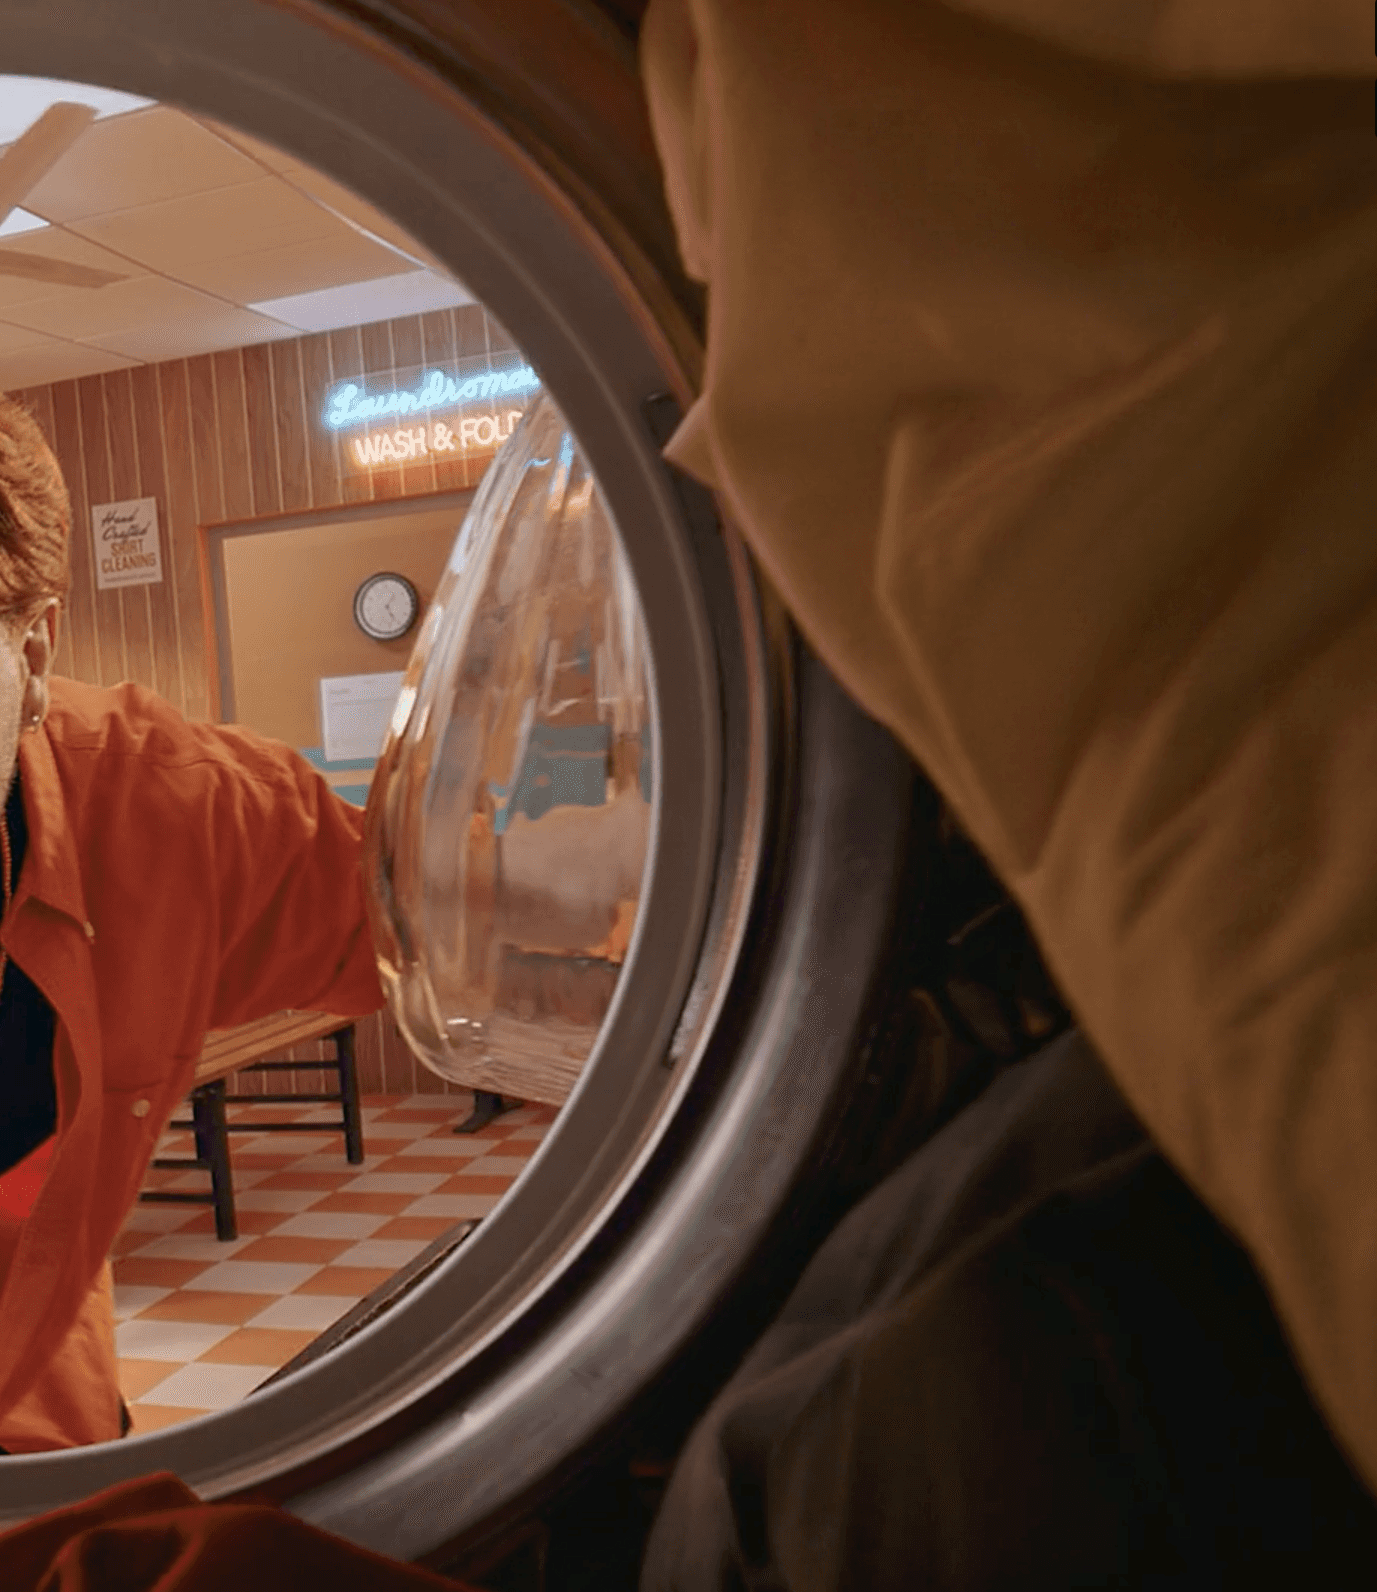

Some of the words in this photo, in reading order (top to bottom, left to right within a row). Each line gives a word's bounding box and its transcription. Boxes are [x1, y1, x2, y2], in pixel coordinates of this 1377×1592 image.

[328, 364, 541, 426] Laundroma
[354, 427, 428, 465] WASH
[433, 422, 455, 452] &
[100, 551, 157, 575] CLEANING
